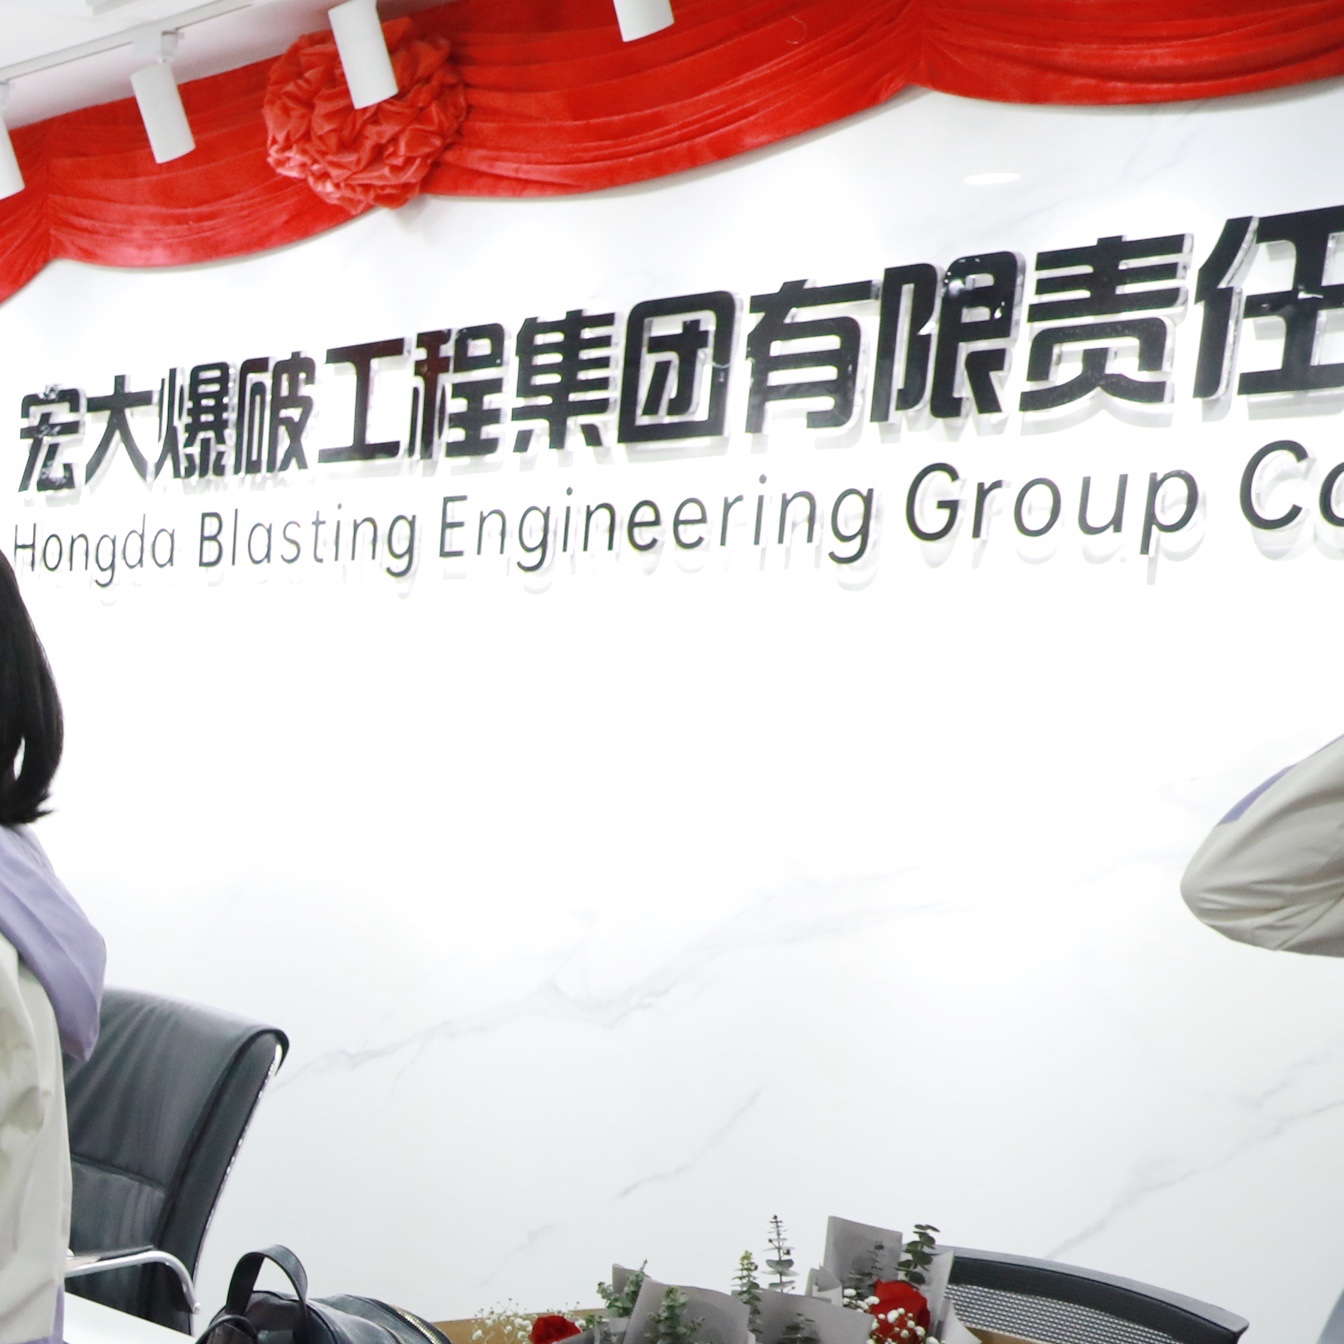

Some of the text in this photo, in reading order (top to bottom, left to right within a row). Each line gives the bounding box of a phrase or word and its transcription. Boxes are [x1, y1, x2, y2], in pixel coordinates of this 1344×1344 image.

[17, 204, 1344, 492] 宏大爆破工程集团有限责任
[13, 514, 175, 587] Hongda
[197, 503, 417, 578] Blasting
[439, 474, 874, 573] Engineering
[905, 462, 1199, 555] Group
